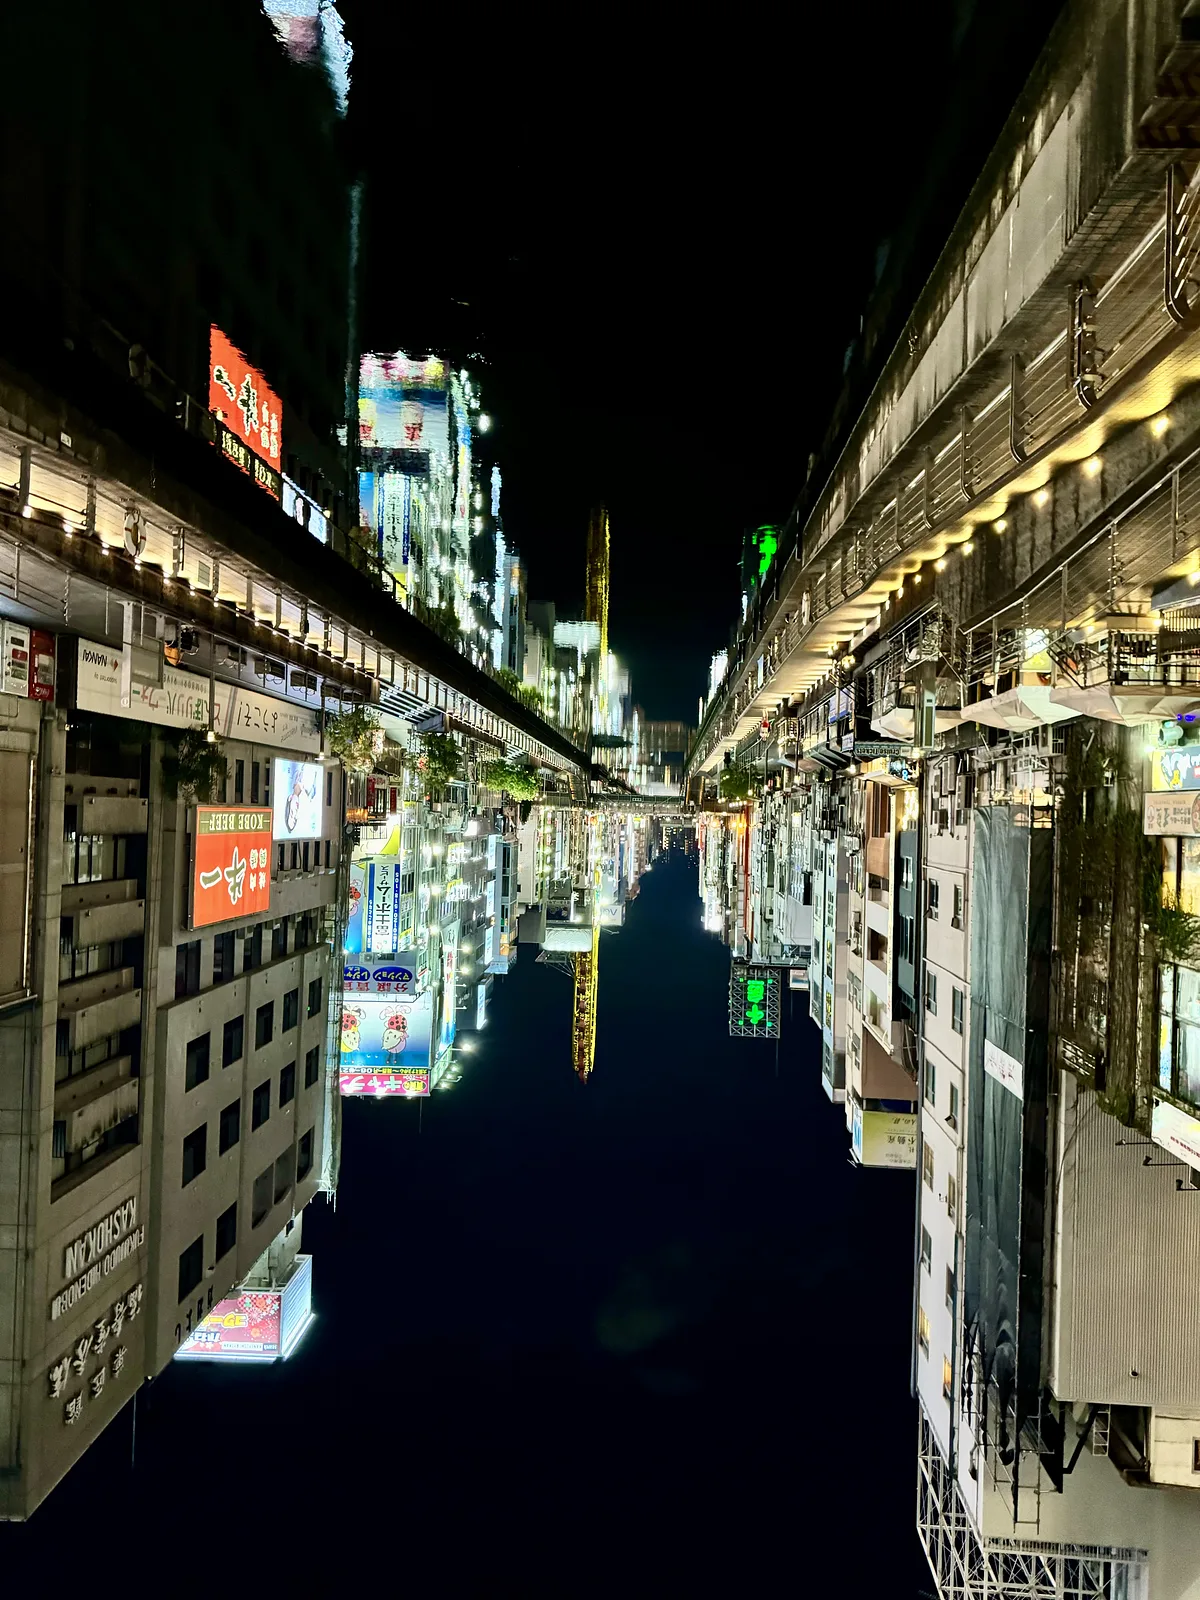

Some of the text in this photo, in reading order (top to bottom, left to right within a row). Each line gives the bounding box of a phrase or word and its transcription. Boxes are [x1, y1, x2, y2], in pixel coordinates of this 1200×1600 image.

[82, 649, 107, 667] NANKAI
[100, 675, 117, 684] supported
[880, 748, 900, 756] Cruise
[209, 814, 263, 831] KOBE BEEF
[200, 846, 246, 905] 牛一
[343, 971, 368, 980] レジャ
[374, 971, 410, 981] マンション
[65, 1196, 136, 1279] KASHOKAN
[51, 1261, 101, 1321] HIDENOBU
